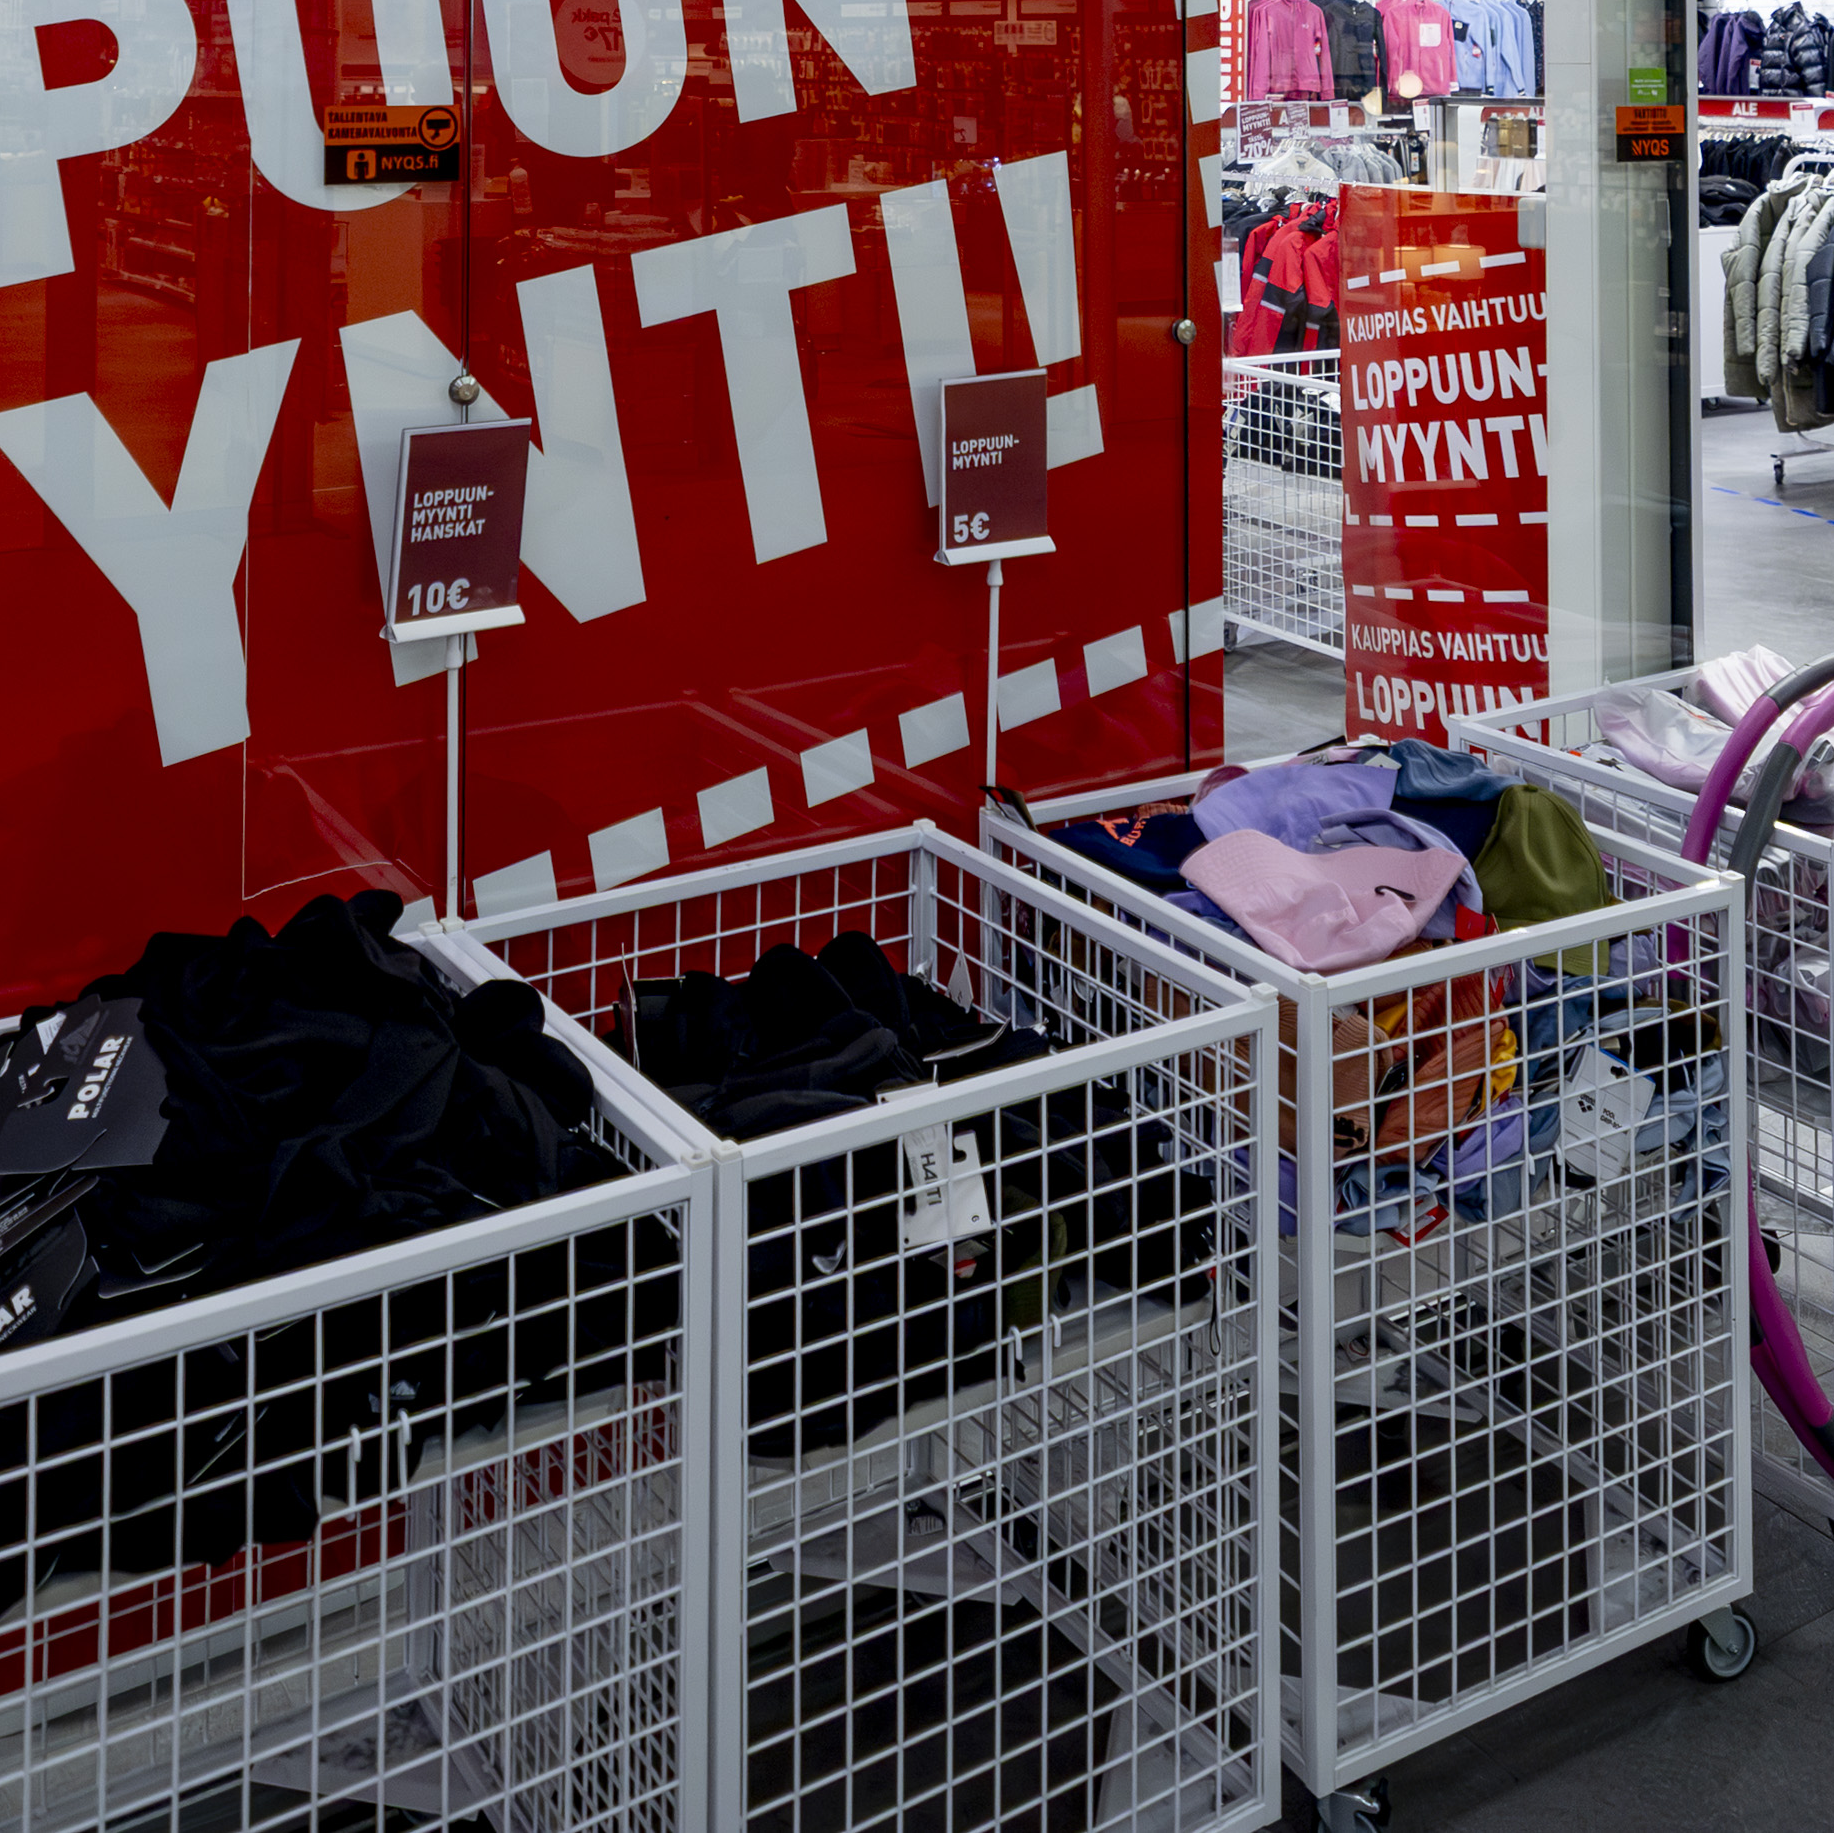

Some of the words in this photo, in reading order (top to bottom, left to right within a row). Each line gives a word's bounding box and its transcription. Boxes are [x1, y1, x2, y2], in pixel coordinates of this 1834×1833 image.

[1732, 102, 1758, 116] ALE
[1241, 139, 1273, 159] -70%
[1632, 139, 1669, 157] NYQS
[381, 153, 439, 170] NYQS.fi
[1347, 304, 1429, 344] KAUPPIAS
[953, 435, 1020, 456] LOPPUUN-
[953, 452, 1004, 471] MYYNTI
[413, 486, 495, 509] LOPPUUN-
[412, 503, 473, 524] MYYNTI
[410, 520, 487, 543] HANSKAT
[952, 511, 991, 543] 5€
[407, 577, 471, 616] 10€
[1351, 623, 1435, 659] KAUPPIAS
[66, 1033, 125, 1121] POLAR
